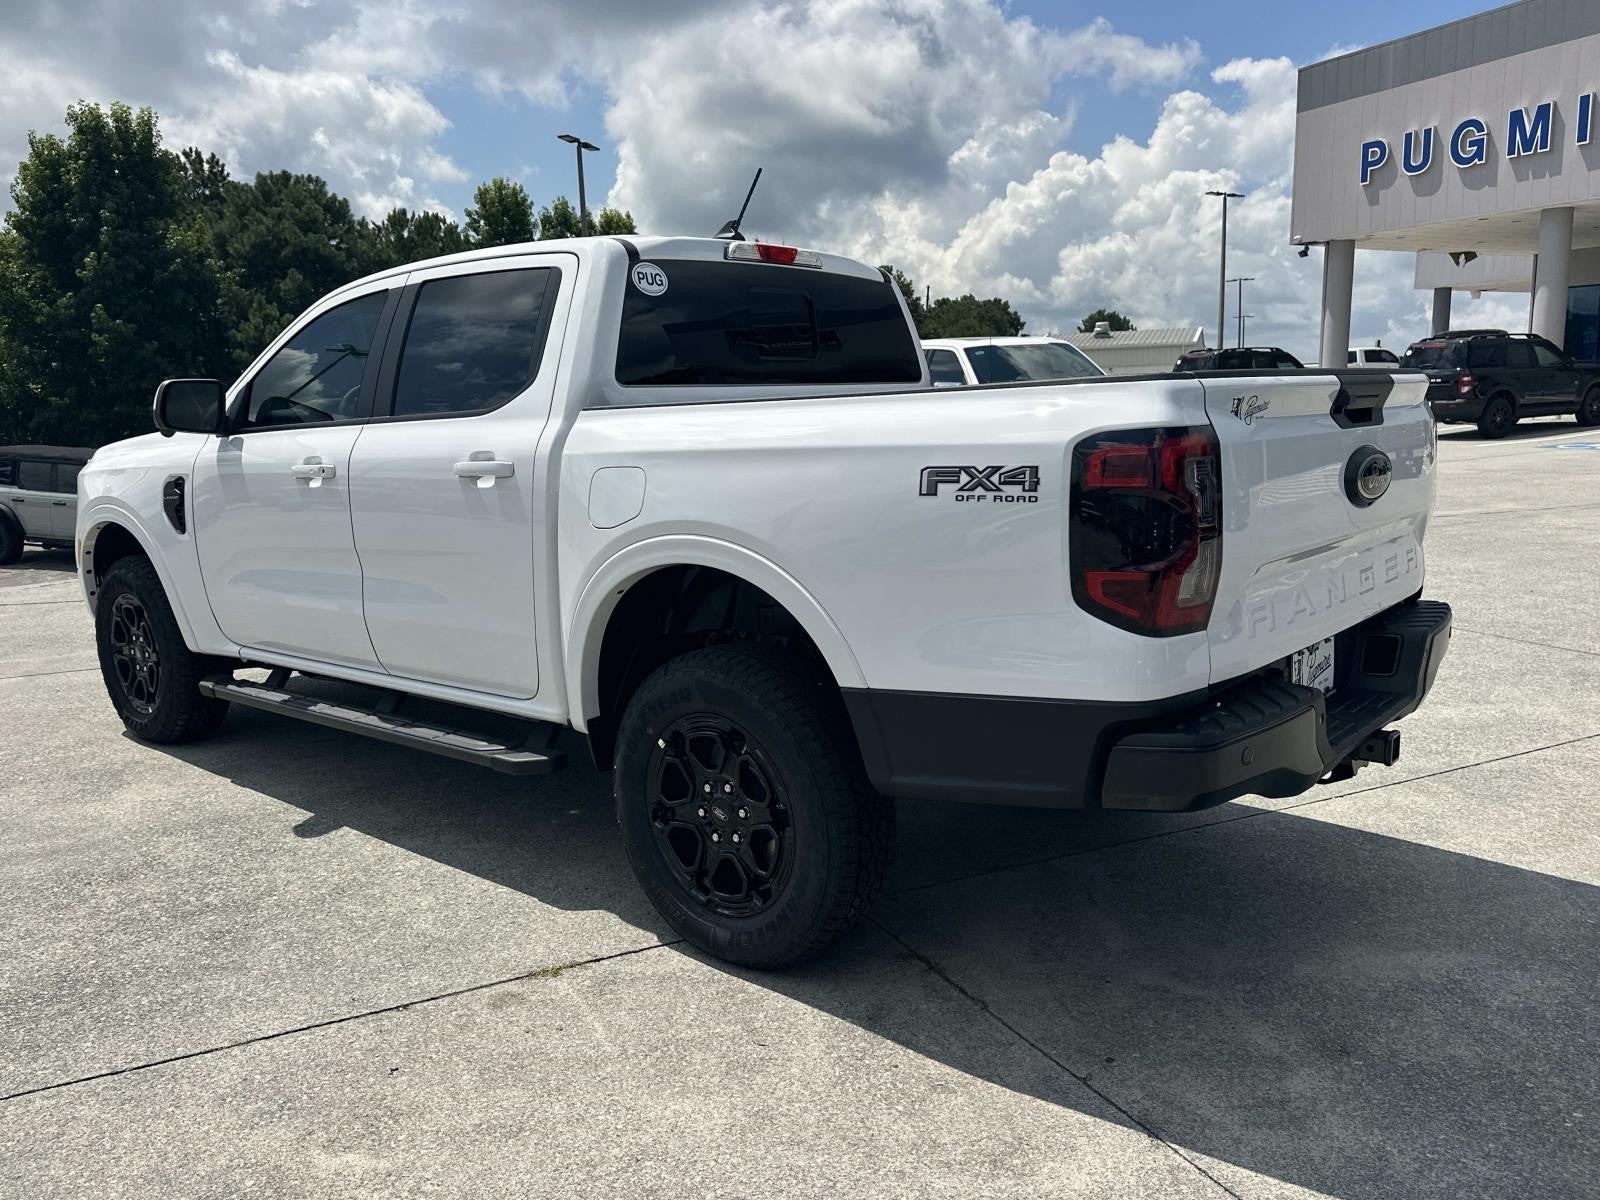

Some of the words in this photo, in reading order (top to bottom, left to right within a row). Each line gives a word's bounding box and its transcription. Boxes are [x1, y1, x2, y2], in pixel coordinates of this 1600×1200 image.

[1359, 91, 1593, 186] PUGMI
[636, 271, 664, 287] PUG
[919, 465, 1040, 496] FX4
[955, 494, 987, 502] OFF
[993, 495, 1038, 503] ROAD
[1248, 545, 1418, 640] RANGER
